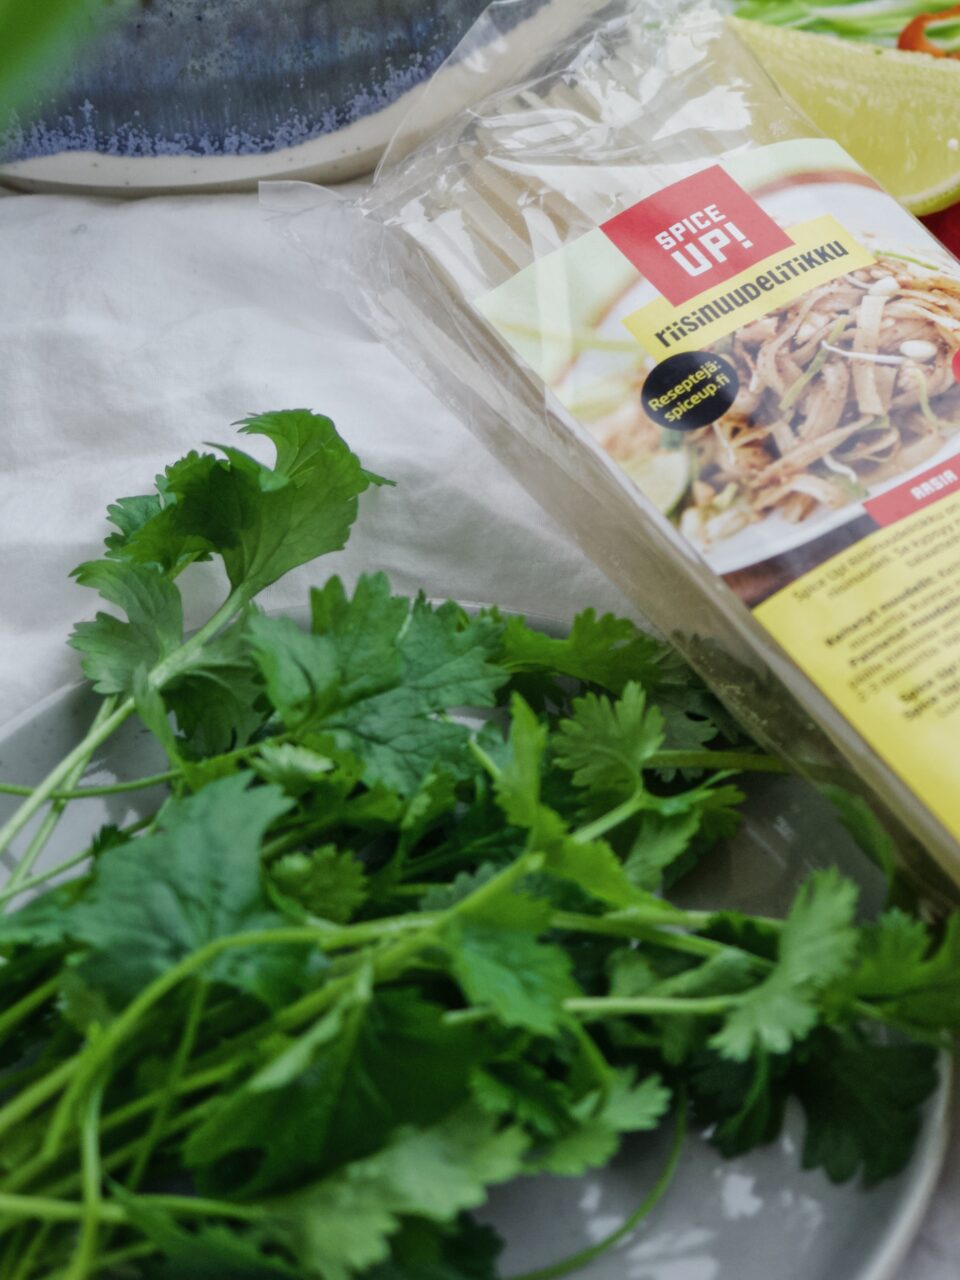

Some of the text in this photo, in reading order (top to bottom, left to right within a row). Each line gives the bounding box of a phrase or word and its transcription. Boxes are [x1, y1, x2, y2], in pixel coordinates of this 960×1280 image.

[654, 204, 726, 250] SPICE
[671, 221, 754, 277] UP!
[647, 360, 722, 412] Reseptejä:
[664, 373, 731, 423] spiceup.fi
